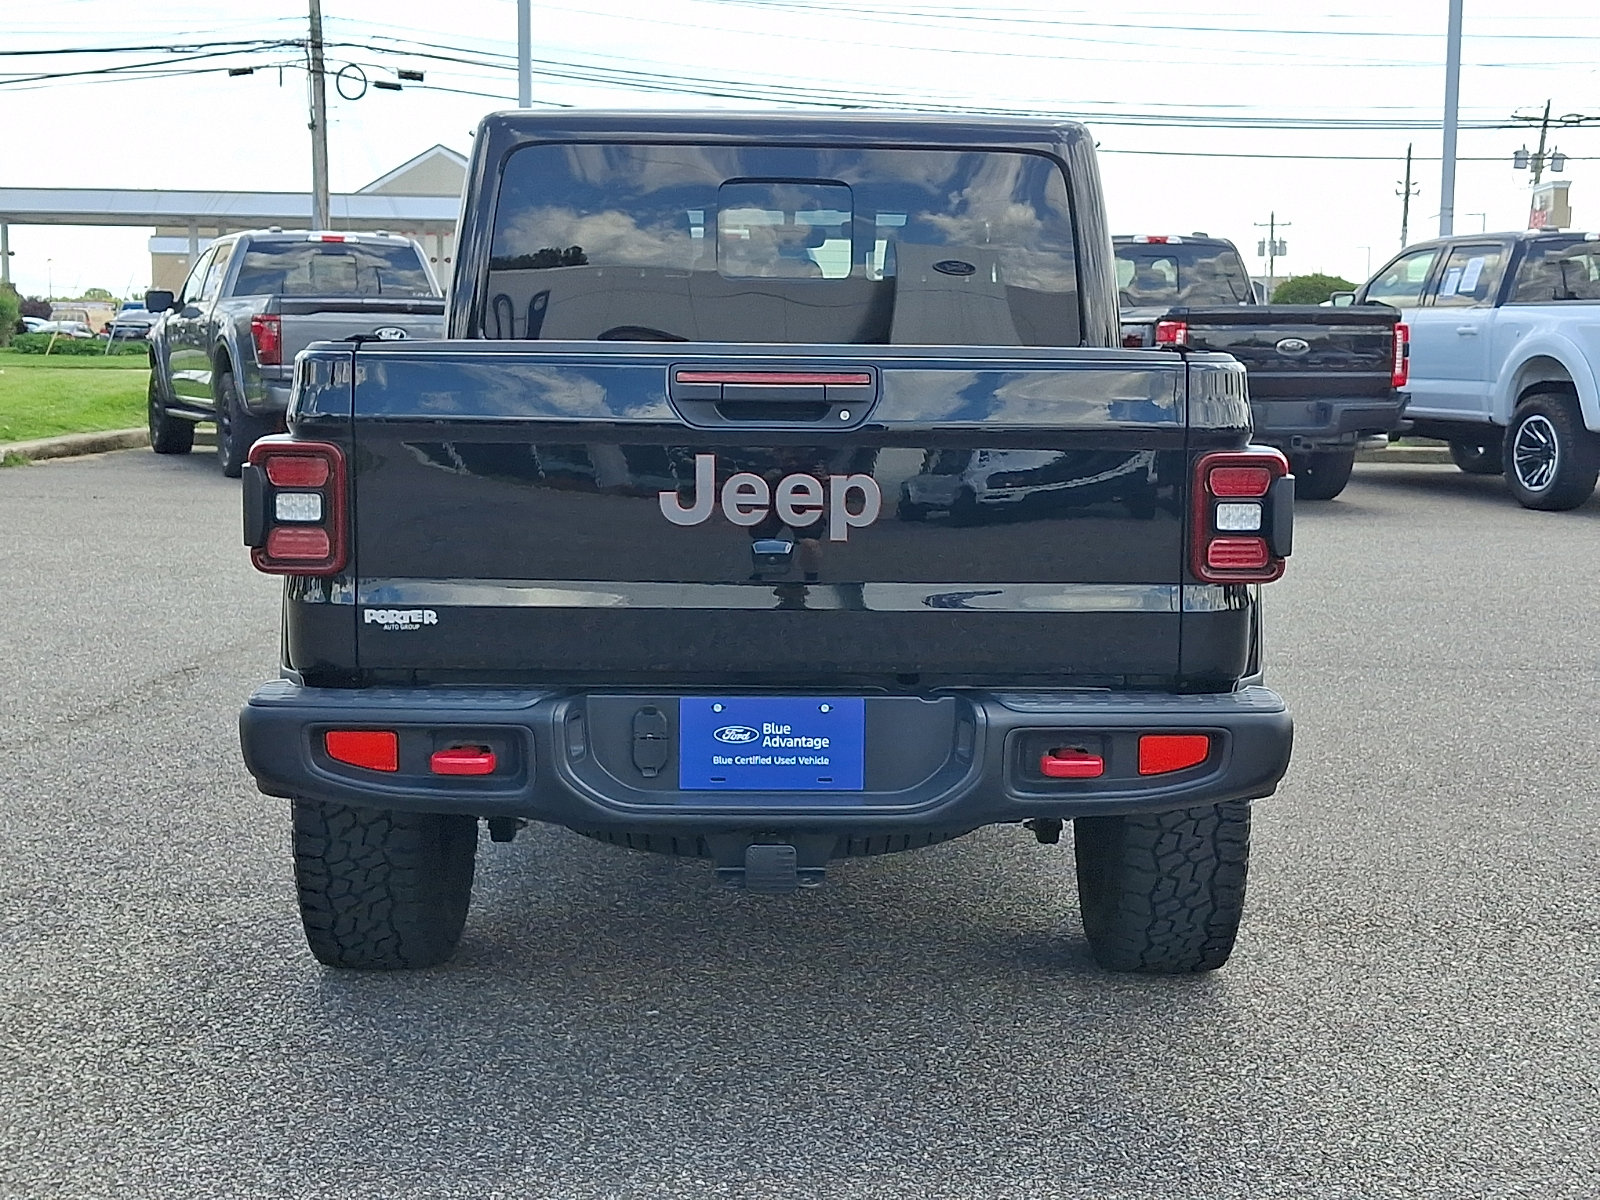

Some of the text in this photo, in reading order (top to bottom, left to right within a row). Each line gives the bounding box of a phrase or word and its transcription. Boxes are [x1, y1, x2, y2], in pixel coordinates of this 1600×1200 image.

[659, 454, 881, 541] Jeep
[364, 609, 438, 625] PORTER
[721, 728, 751, 741] Ford
[762, 723, 791, 734] Blue
[762, 736, 830, 750] Advantage
[712, 756, 830, 765] Blue Certified Used Vehicle
